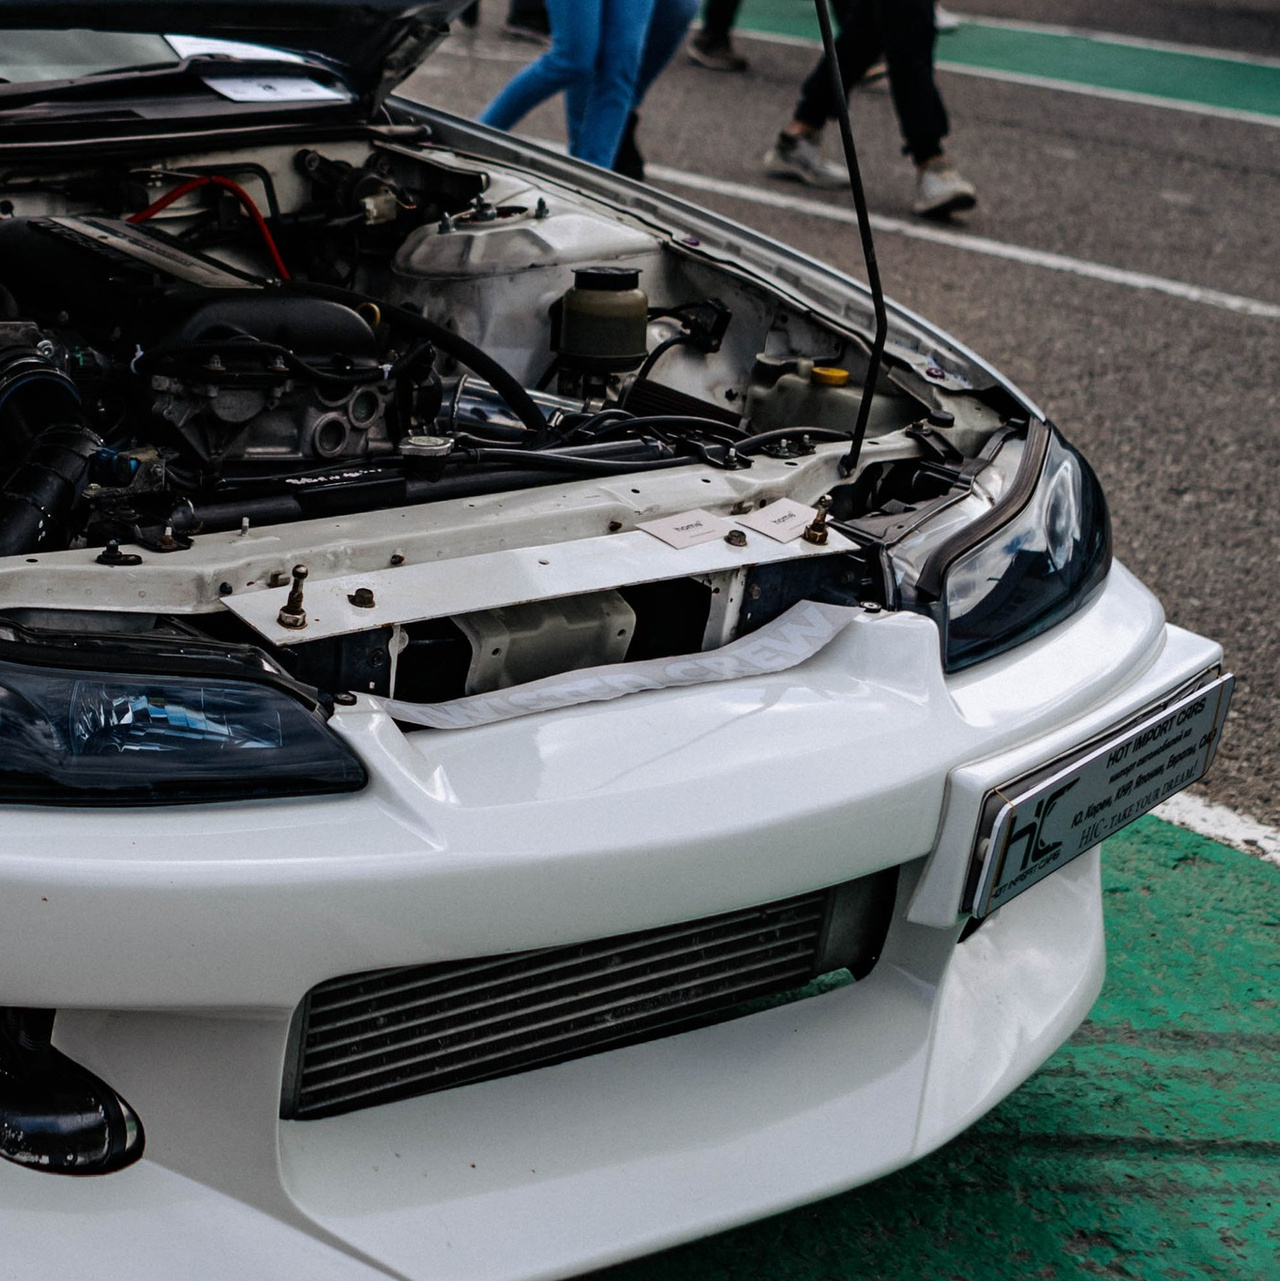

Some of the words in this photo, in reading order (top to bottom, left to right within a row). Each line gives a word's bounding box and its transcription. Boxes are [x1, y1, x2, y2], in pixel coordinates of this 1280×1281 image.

[664, 604, 838, 684] CREW
[1106, 741, 1133, 769] HOT
[1132, 716, 1177, 754] IMPORT
[1176, 697, 1207, 726] CARS
[1109, 803, 1135, 829] TAKE
[1136, 788, 1161, 812] YOUR
